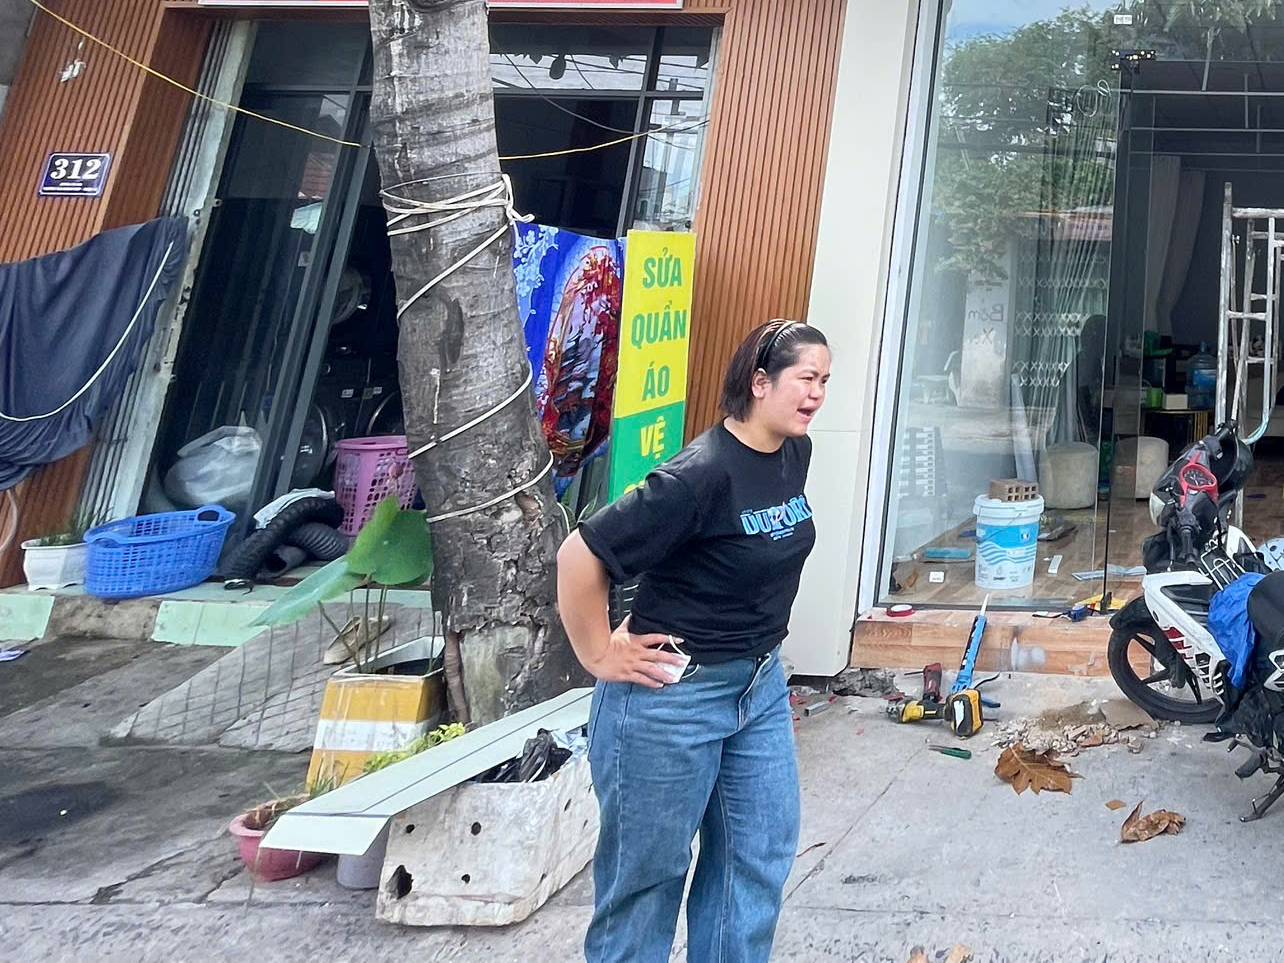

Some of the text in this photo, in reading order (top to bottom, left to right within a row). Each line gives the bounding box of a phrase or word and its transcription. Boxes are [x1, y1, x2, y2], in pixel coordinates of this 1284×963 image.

[50, 158, 102, 180] 312
[642, 246, 682, 289] SỬA
[631, 300, 688, 350] QUẦN
[642, 361, 670, 402] ÁO
[640, 419, 666, 459] VỆ
